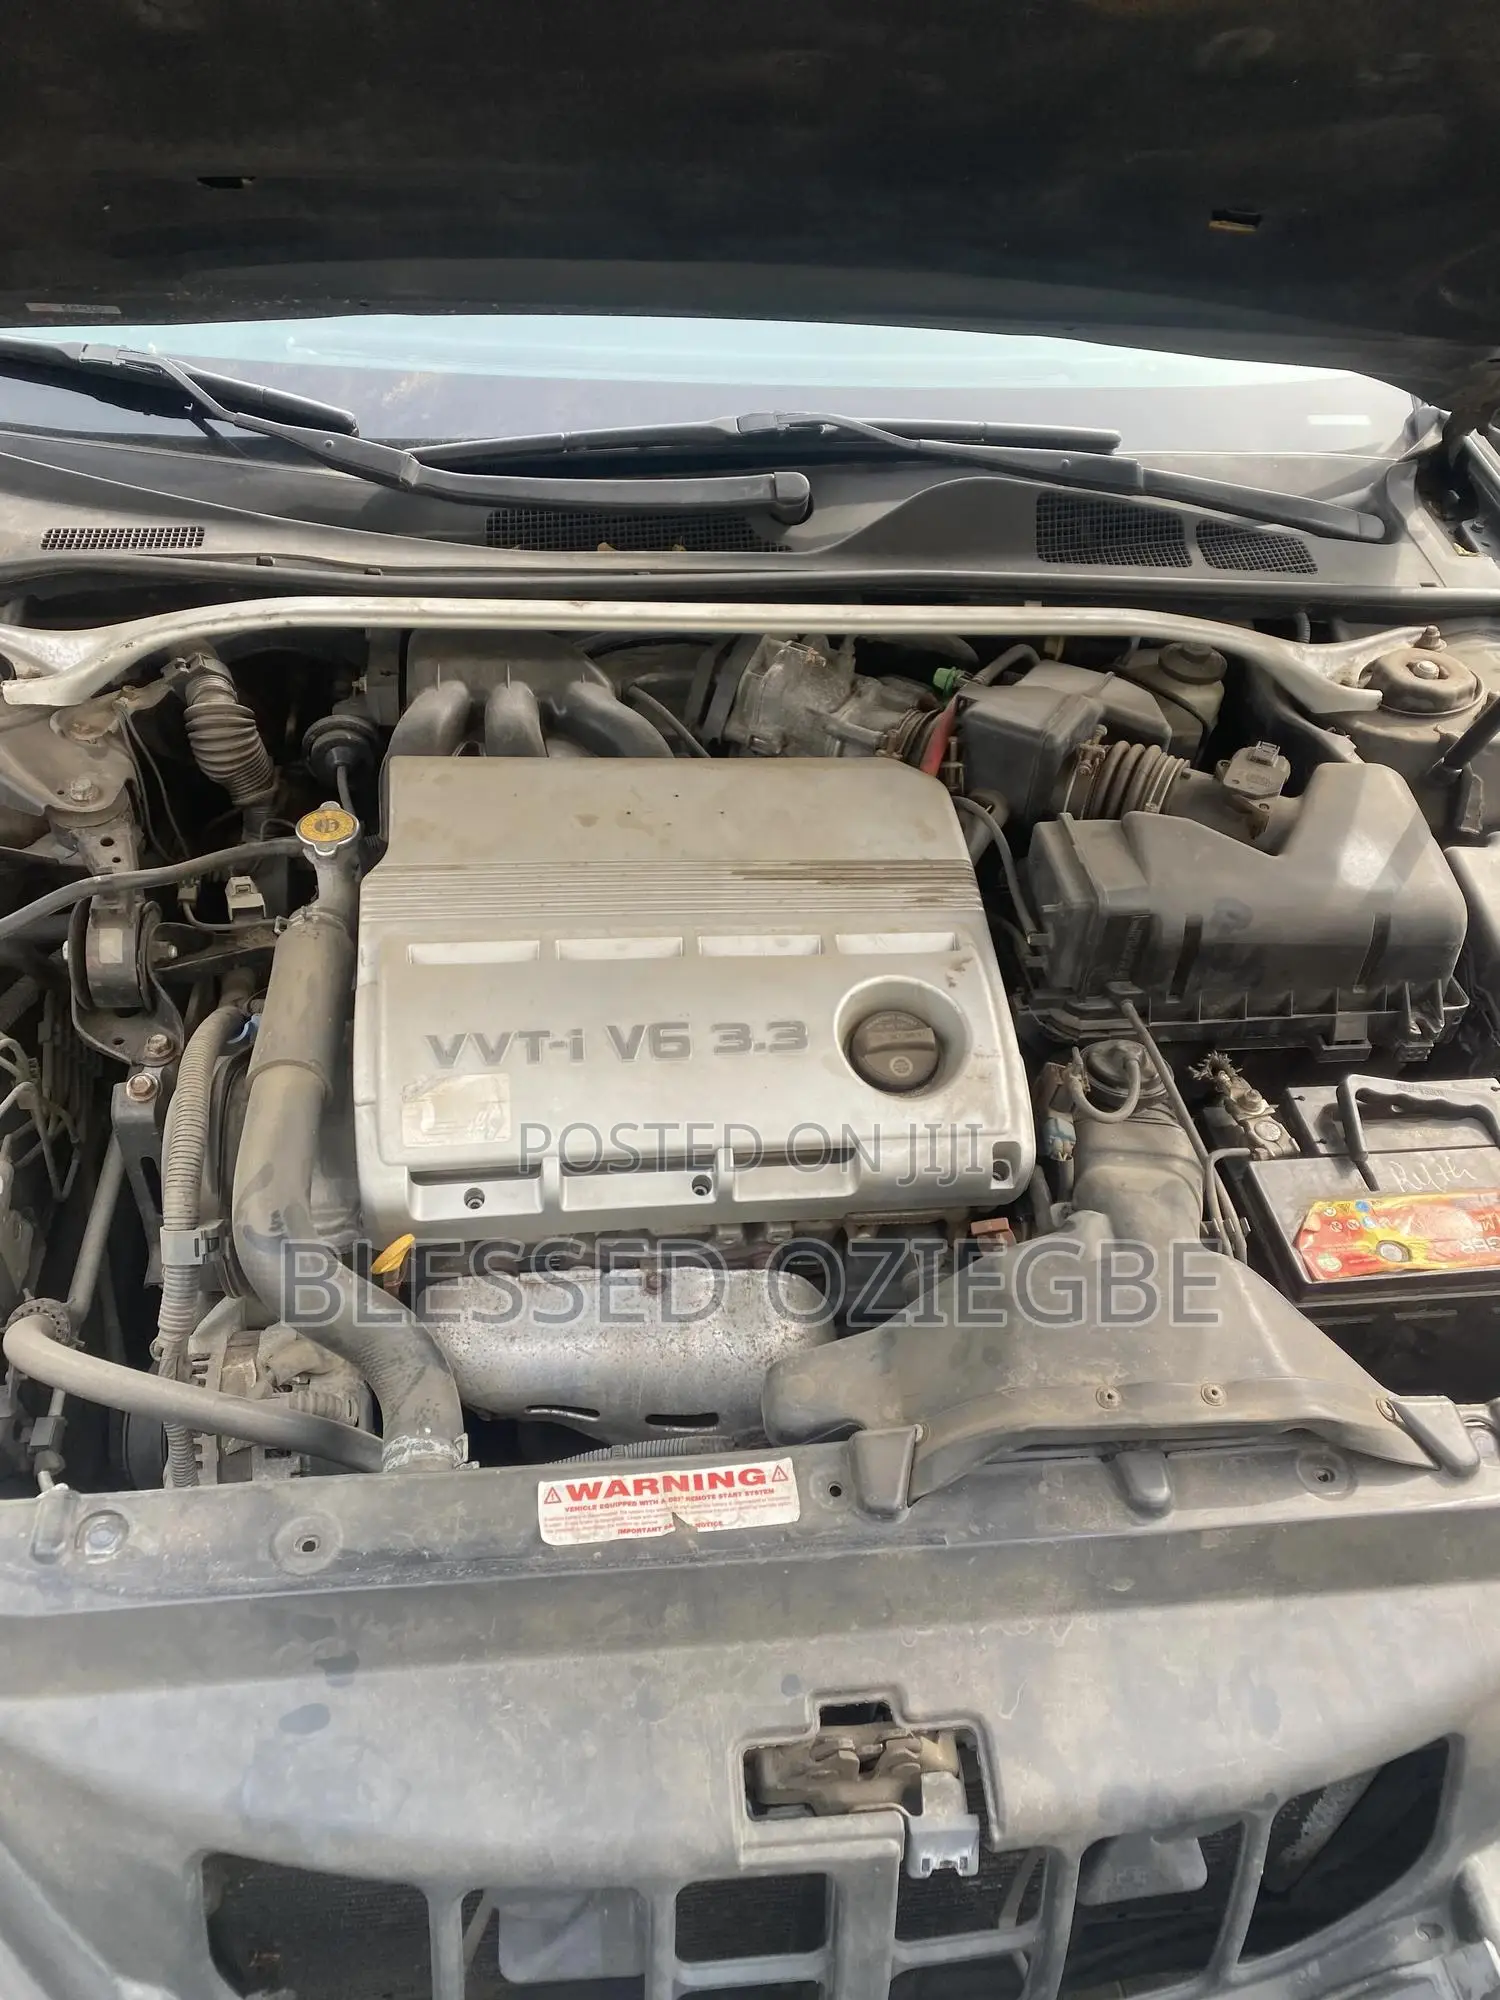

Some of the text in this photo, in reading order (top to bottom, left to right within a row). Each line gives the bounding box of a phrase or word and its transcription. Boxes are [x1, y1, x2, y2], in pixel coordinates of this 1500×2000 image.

[425, 1019, 810, 1069] VVT-i V6 3.3
[566, 1468, 766, 1502] WARNING
[564, 1504, 597, 1513] VEHICLE
[599, 1501, 638, 1510] EQUIPPED
[639, 1499, 659, 1507] WITH
[685, 1493, 717, 1502] REMOTE
[718, 1491, 742, 1499] START
[744, 1488, 775, 1497] SYSTEM
[617, 1526, 662, 1535] IMPORTANT
[695, 1520, 723, 1528] NOTICE
